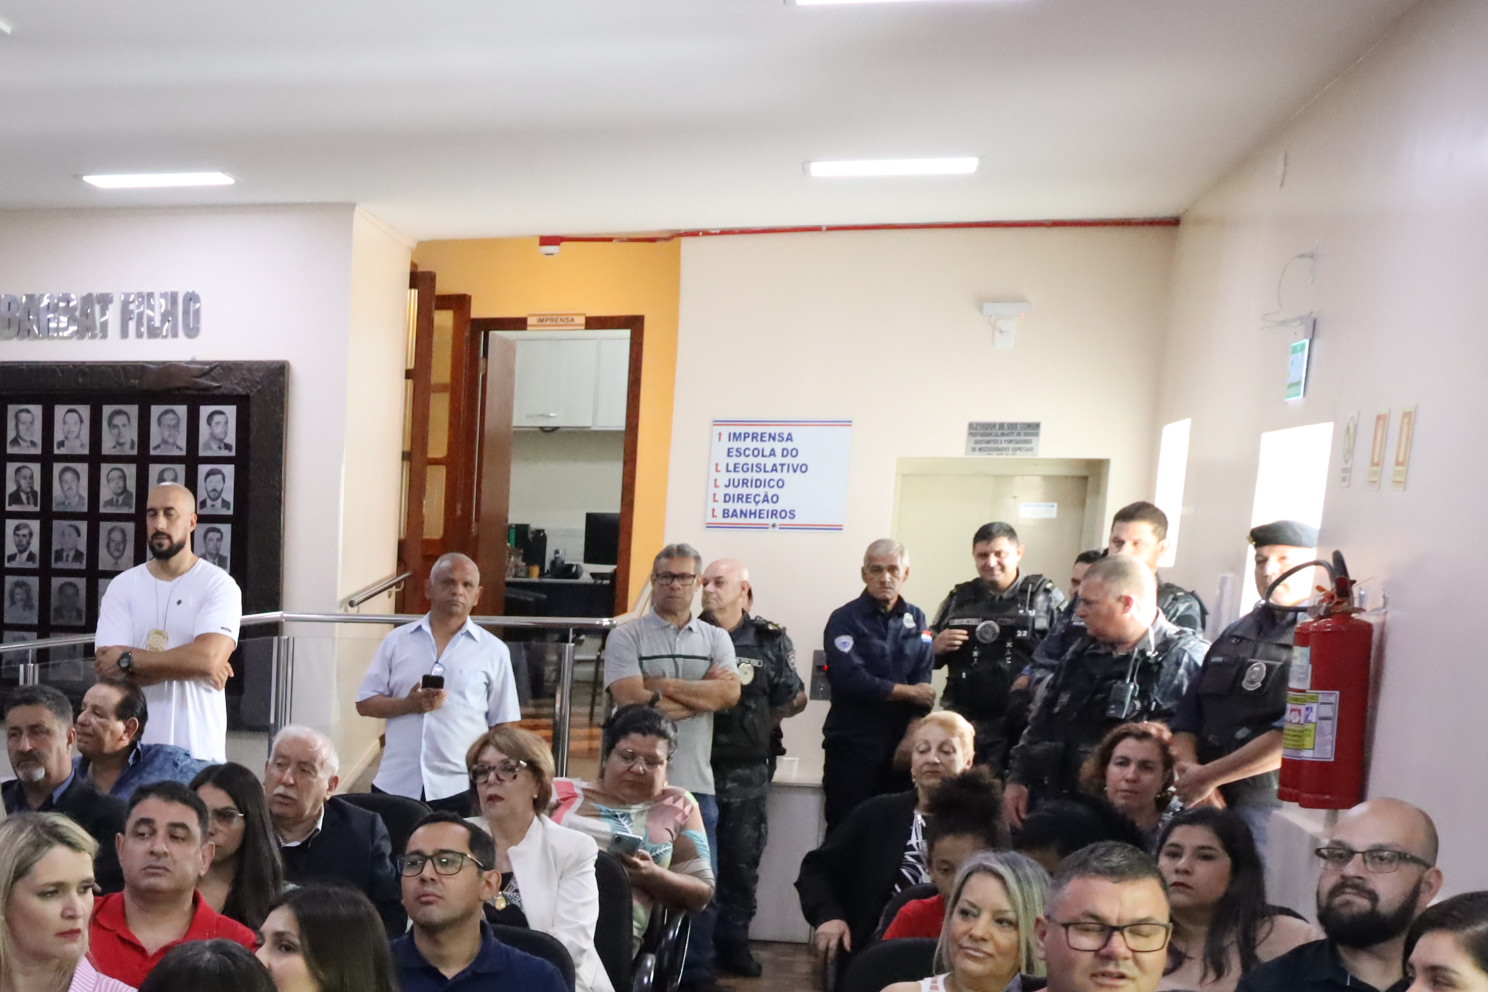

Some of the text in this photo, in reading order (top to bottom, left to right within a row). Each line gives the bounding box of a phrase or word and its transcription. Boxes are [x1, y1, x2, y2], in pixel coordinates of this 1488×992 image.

[536, 316, 576, 324] IMPRENSA
[728, 432, 794, 442] IMPRENSA
[726, 447, 799, 458] ESCOLA DO
[725, 463, 809, 473] LEGISLATIVO
[724, 476, 785, 489] JURÍDICO
[723, 492, 780, 506] DIREÇÃO
[722, 508, 796, 520] BANHEIROS
